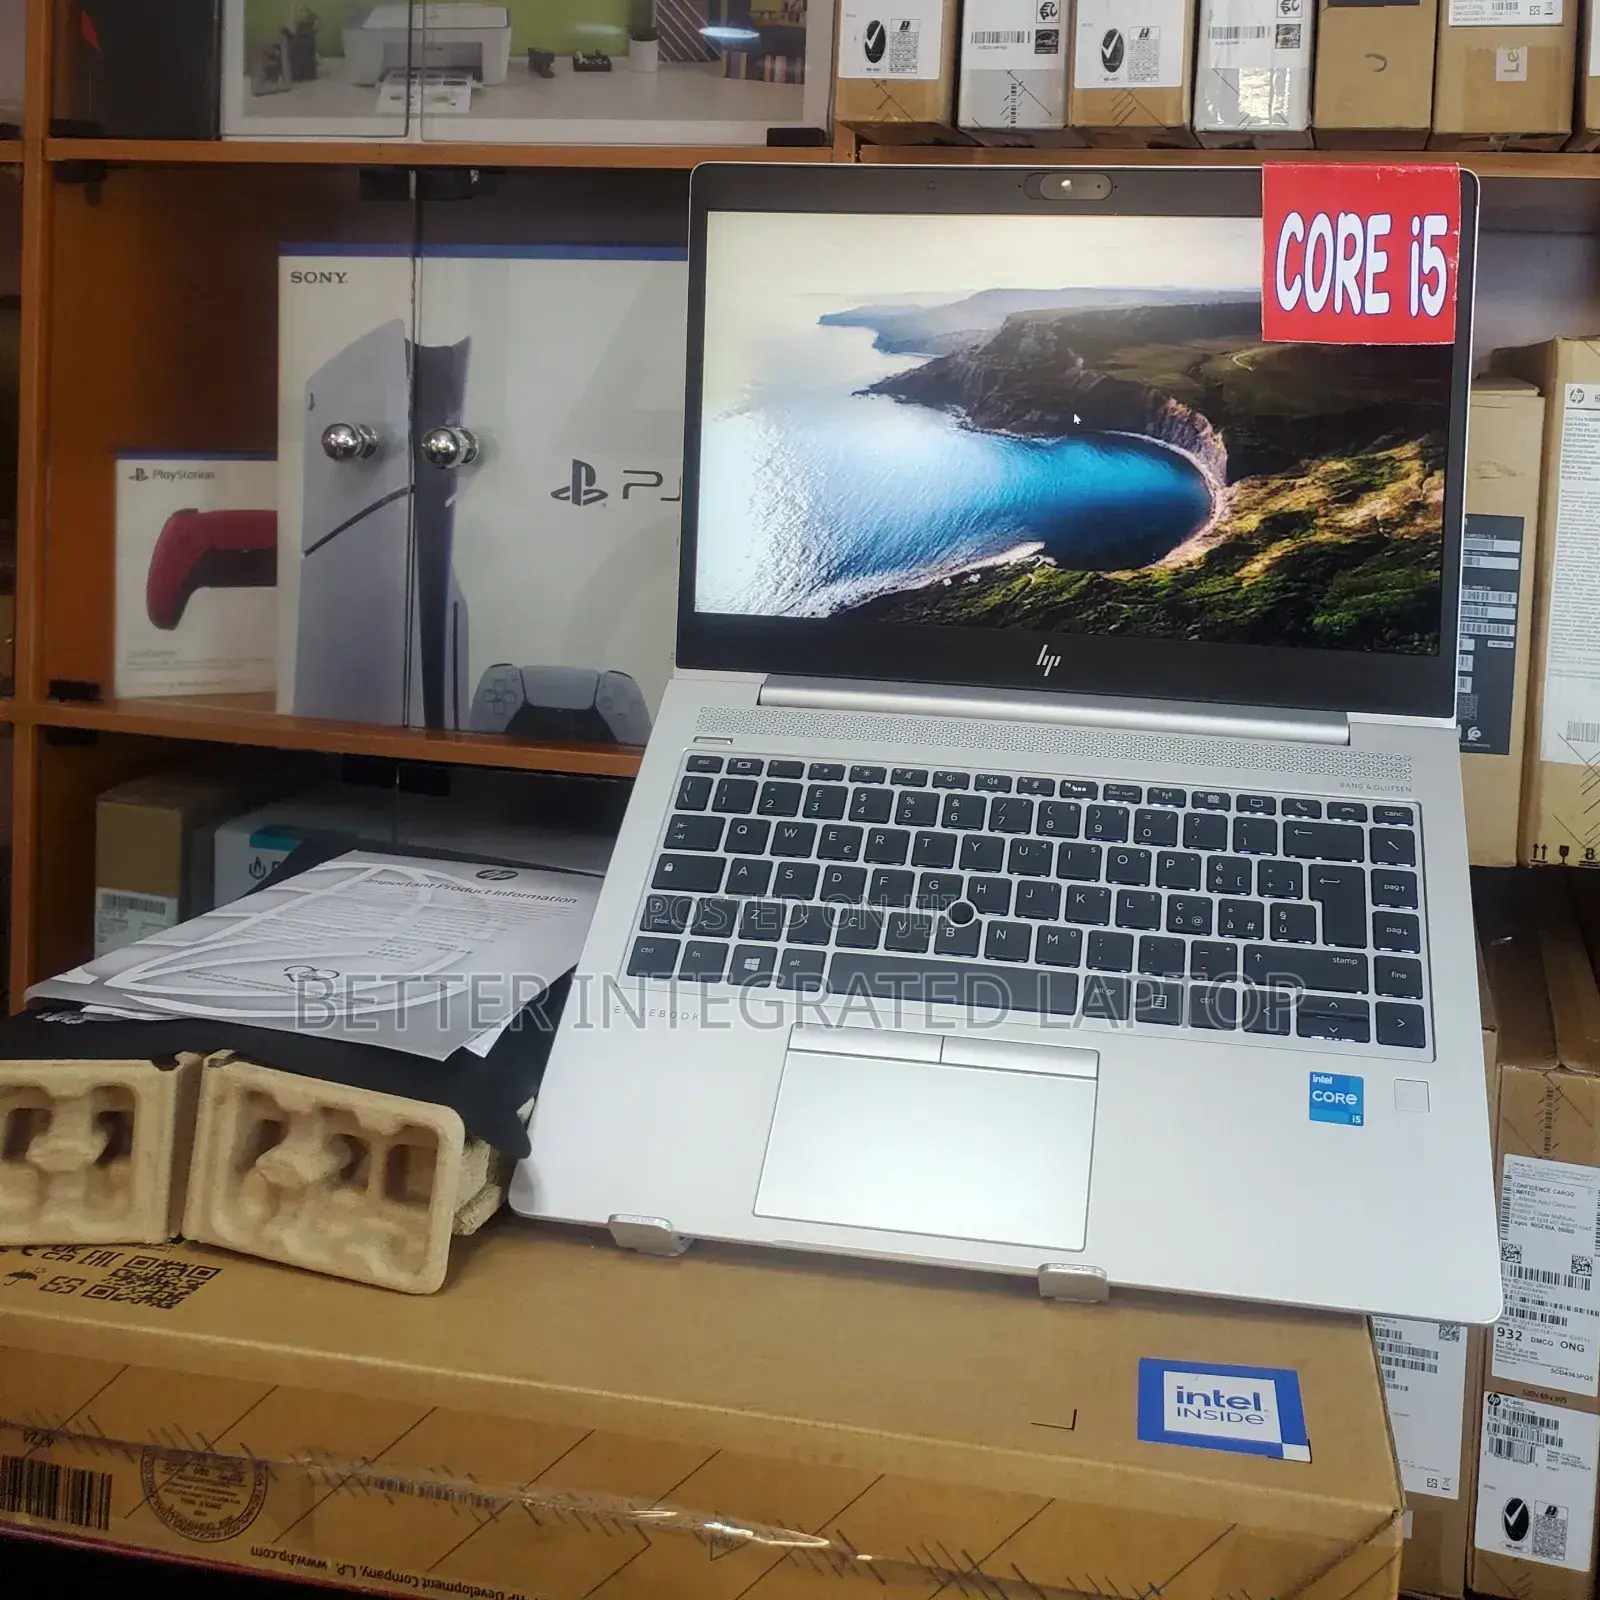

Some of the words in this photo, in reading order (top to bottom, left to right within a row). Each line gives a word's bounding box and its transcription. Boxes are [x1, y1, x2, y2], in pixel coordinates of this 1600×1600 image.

[1276, 210, 1392, 316] CORE
[1408, 214, 1448, 318] i5
[290, 270, 348, 284] SONY
[152, 468, 215, 482] PlayStation
[1372, 784, 1412, 792] OLUFSEN
[765, 800, 774, 808] 2
[812, 803, 819, 811] 3
[857, 805, 865, 814] 4
[904, 810, 911, 818] 5
[950, 813, 958, 821] 6
[998, 816, 1005, 824] 7
[737, 825, 748, 835] Q
[784, 828, 798, 838] W
[829, 831, 837, 841] E
[875, 835, 885, 844] R
[922, 839, 931, 847] T
[971, 842, 980, 851] Y
[1019, 847, 1028, 856] U
[1117, 855, 1128, 864] O
[1166, 859, 1175, 868] P
[364, 878, 434, 889] Important
[436, 884, 495, 895] Product
[493, 889, 578, 904] Information
[738, 866, 748, 876] A
[785, 869, 794, 879] S
[832, 873, 842, 882] D
[880, 876, 888, 886] F
[929, 880, 939, 890] G
[977, 884, 986, 894] H
[1026, 889, 1033, 898] J
[1076, 894, 1085, 904] K
[1126, 898, 1133, 908] L
[751, 910, 760, 919] Z
[801, 913, 809, 922] X
[849, 918, 858, 927] C
[897, 921, 907, 930] V
[946, 928, 955, 937] B
[996, 930, 1006, 939] N
[1047, 934, 1058, 944] M
[1332, 957, 1358, 966] stamp
[1312, 1074, 1333, 1084] intel
[1352, 1115, 1361, 1123] i5
[1512, 1182, 1551, 1193] CONFIDENCE
[1552, 1188, 1575, 1197] CARGO
[1512, 1188, 1536, 1196] LIMITED
[1497, 1327, 1523, 1341] 932
[1530, 1336, 1554, 1346] DMCQ
[1560, 1340, 1585, 1352] ONG
[1176, 1385, 1260, 1413] intel
[1488, 1393, 1501, 1406] hp
[250, 1546, 328, 1570] www.hp.com
[360, 1566, 418, 1588] Company,
[421, 1577, 506, 1600] Development
